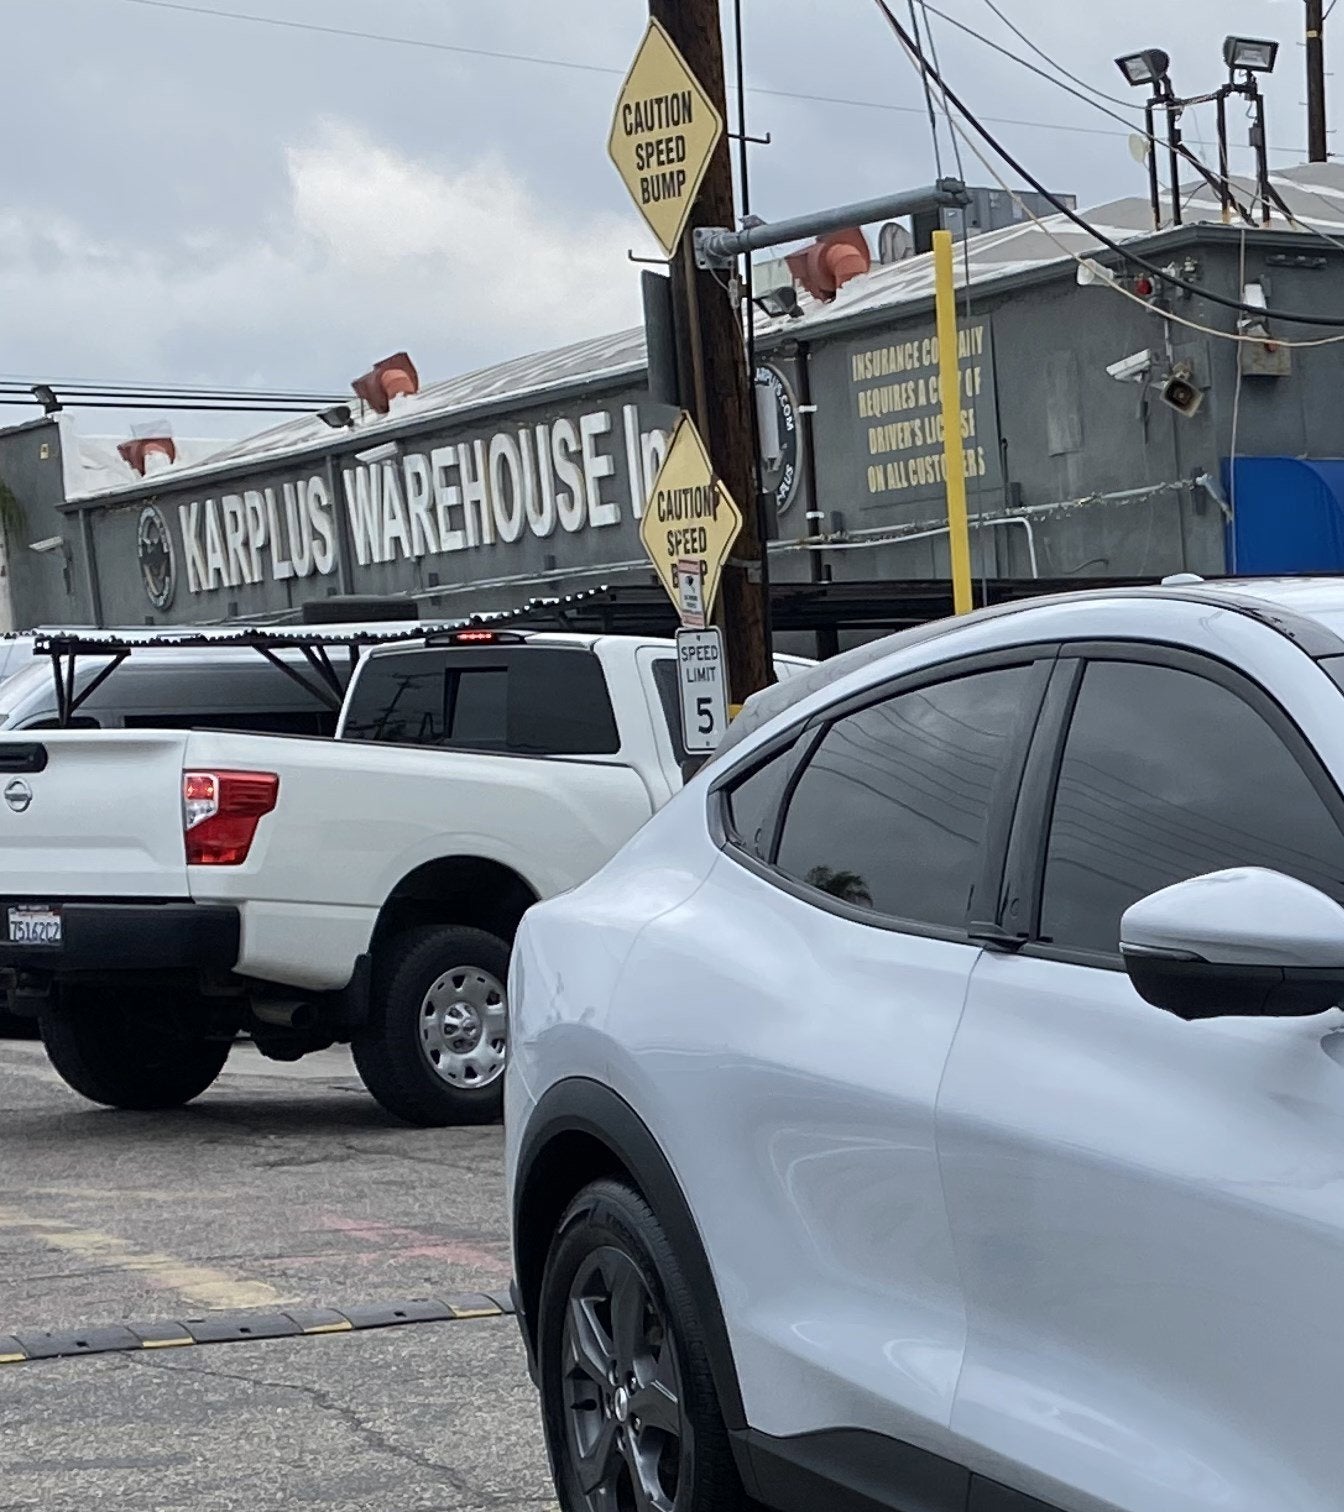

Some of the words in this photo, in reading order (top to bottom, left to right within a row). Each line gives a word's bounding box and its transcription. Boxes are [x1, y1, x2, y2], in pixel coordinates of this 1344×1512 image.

[622, 90, 693, 136] CAUTION
[635, 135, 686, 171] SPEED
[640, 169, 686, 204] BUMP
[852, 341, 920, 382] INSURANCE
[922, 326, 983, 366] COANY
[858, 380, 915, 418] REQUIRES
[918, 379, 927, 406] A
[965, 366, 981, 397] OF
[868, 418, 923, 454] DRIVER'S
[867, 464, 886, 493] ON
[887, 461, 909, 490] ALL
[178, 475, 338, 593] KARPLUS
[343, 411, 621, 566] WAREHOUSE
[623, 404, 668, 519] In
[657, 485, 712, 523] CAUTION
[667, 526, 707, 556] SPEED
[670, 560, 708, 588] BP
[681, 644, 718, 661] SPEED
[686, 666, 716, 683] LIMIT
[696, 697, 714, 734] 5
